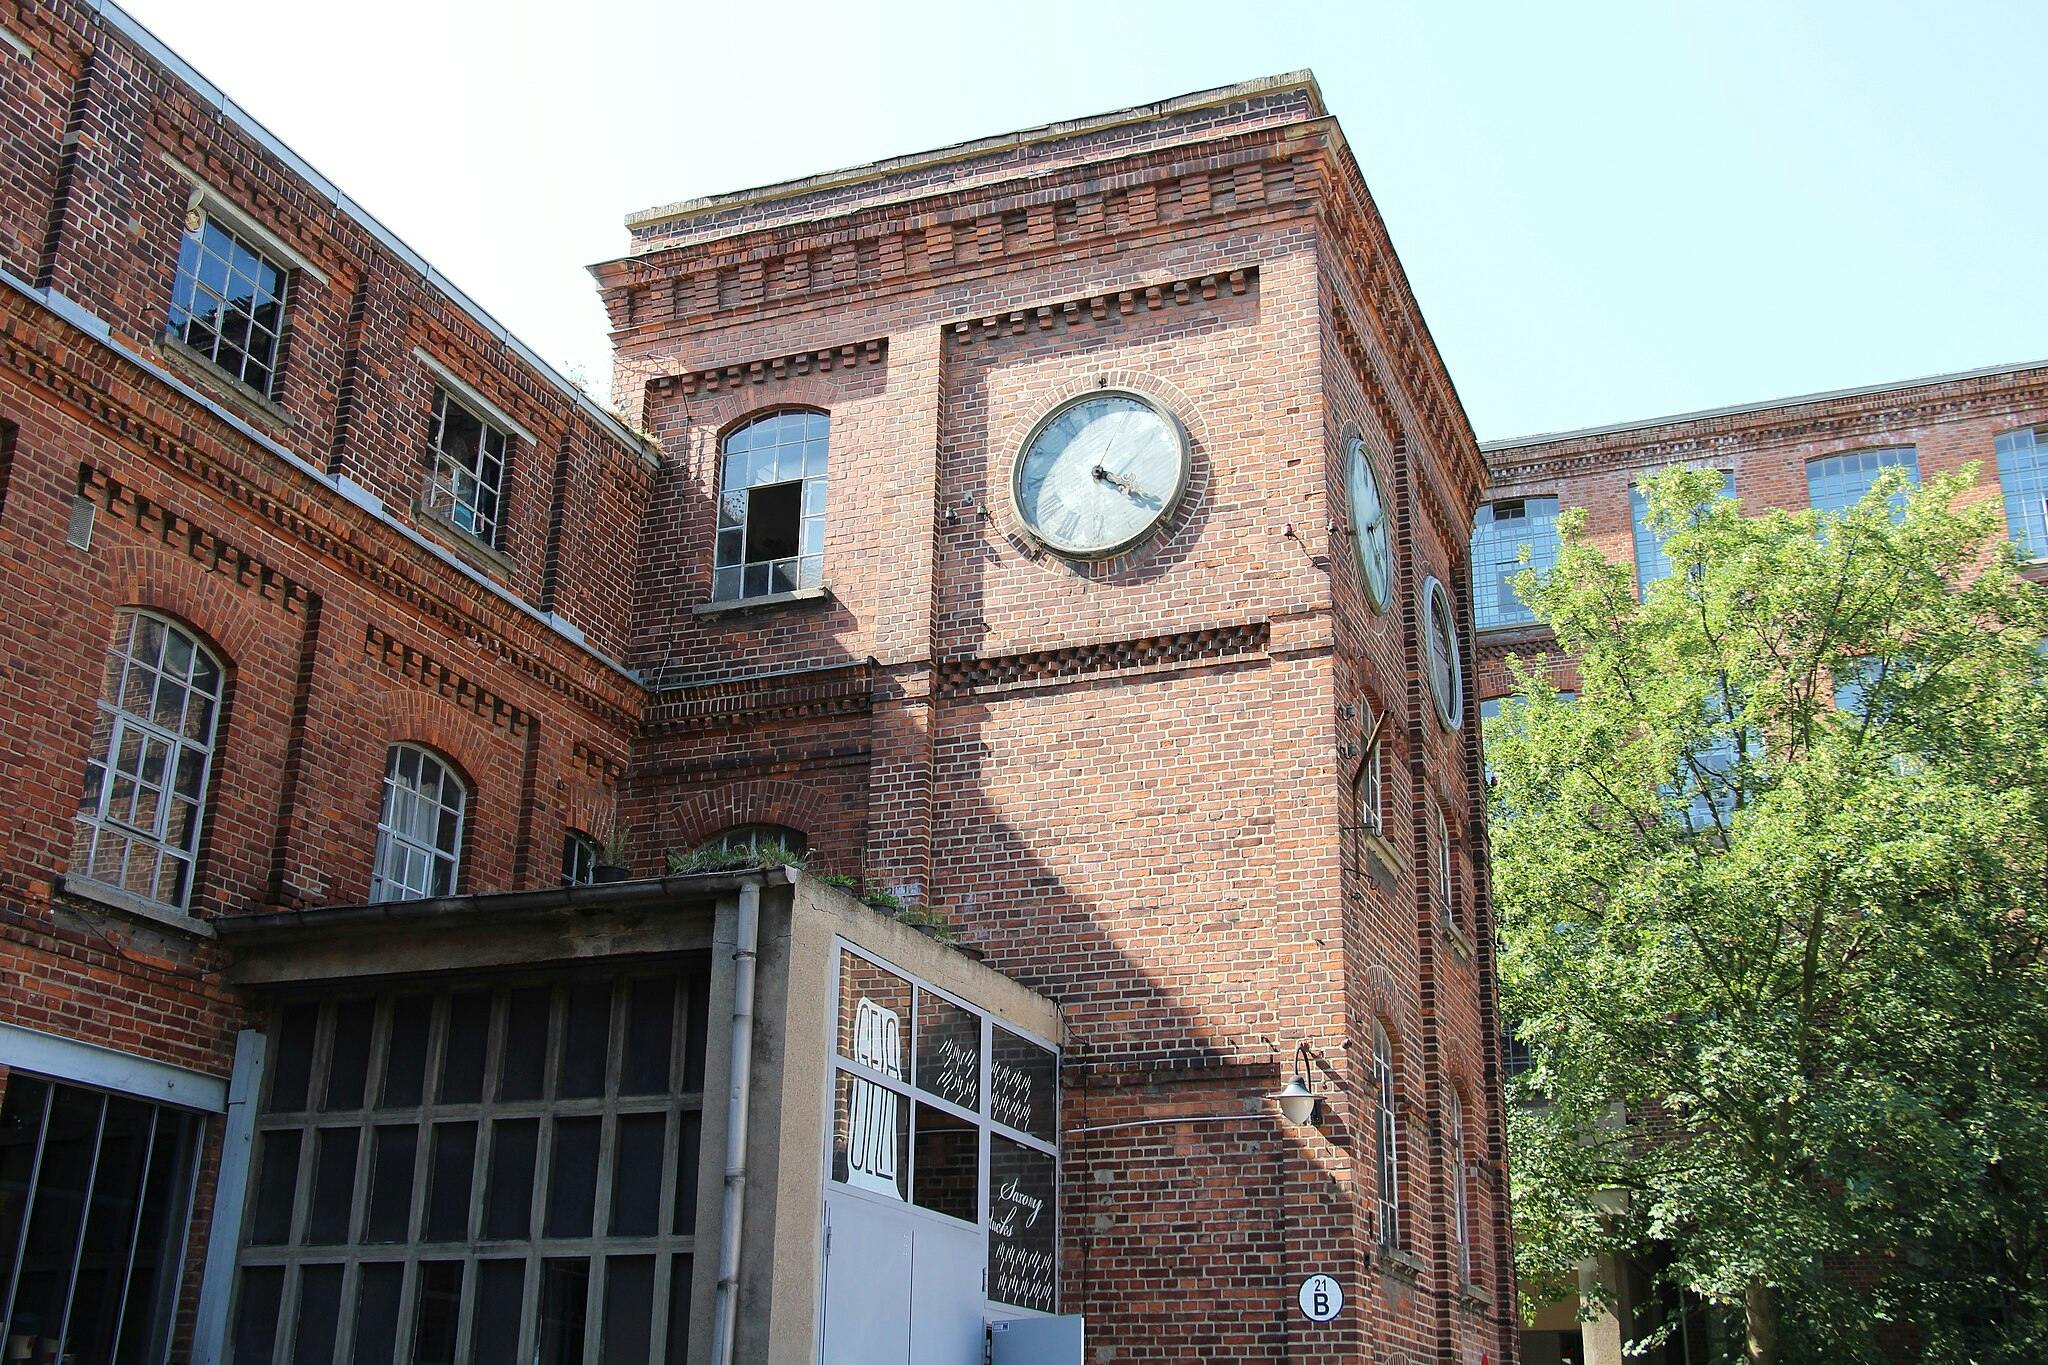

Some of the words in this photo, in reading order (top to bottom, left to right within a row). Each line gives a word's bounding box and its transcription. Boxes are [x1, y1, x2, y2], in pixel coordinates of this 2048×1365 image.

[997, 1177, 1044, 1228] Saxony
[1314, 1279, 1327, 1292] 21
[1313, 1293, 1330, 1316] B
